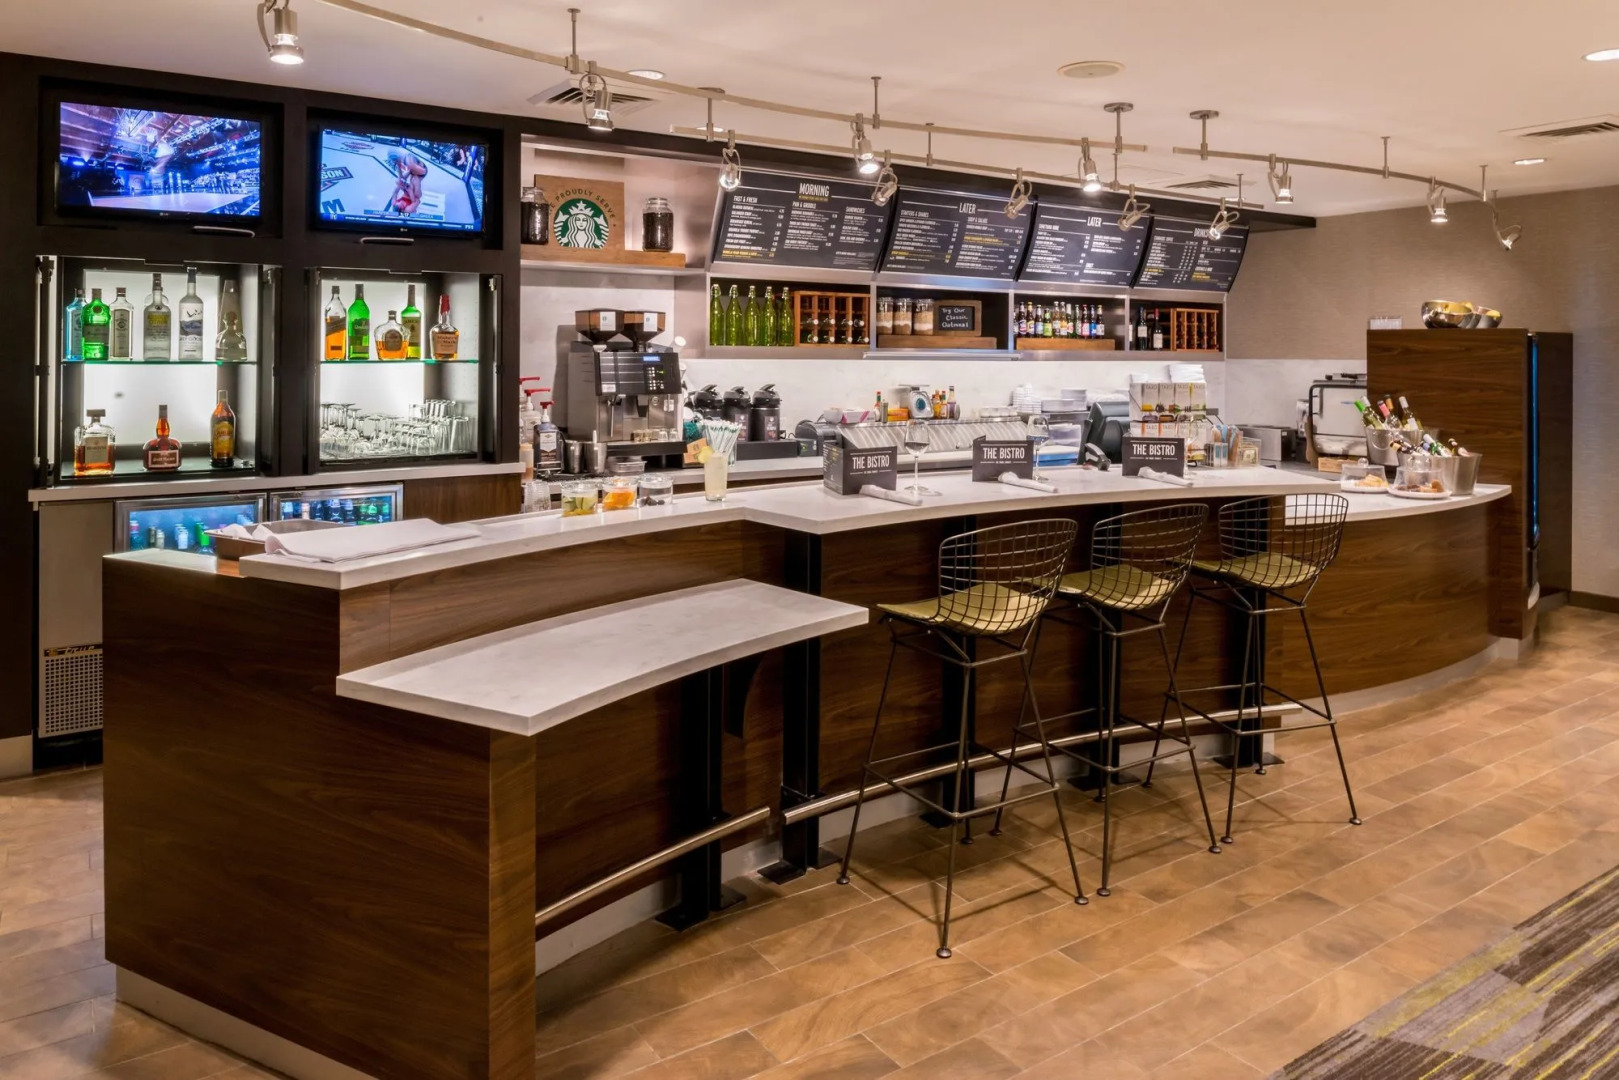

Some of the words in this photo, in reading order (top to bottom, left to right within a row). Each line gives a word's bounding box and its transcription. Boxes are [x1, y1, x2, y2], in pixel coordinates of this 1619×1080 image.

[799, 182, 830, 197] MORNING
[555, 189, 593, 201] PROUDLY
[596, 195, 616, 218] SERVE
[959, 202, 976, 214] LATER
[1087, 216, 1102, 227] LATER
[982, 447, 998, 459] THE
[999, 447, 1025, 459] BISTRO
[1132, 444, 1148, 455] THE
[1149, 444, 1176, 456] BISTRO
[852, 456, 866, 470] THE
[866, 454, 890, 469] BISTRO
